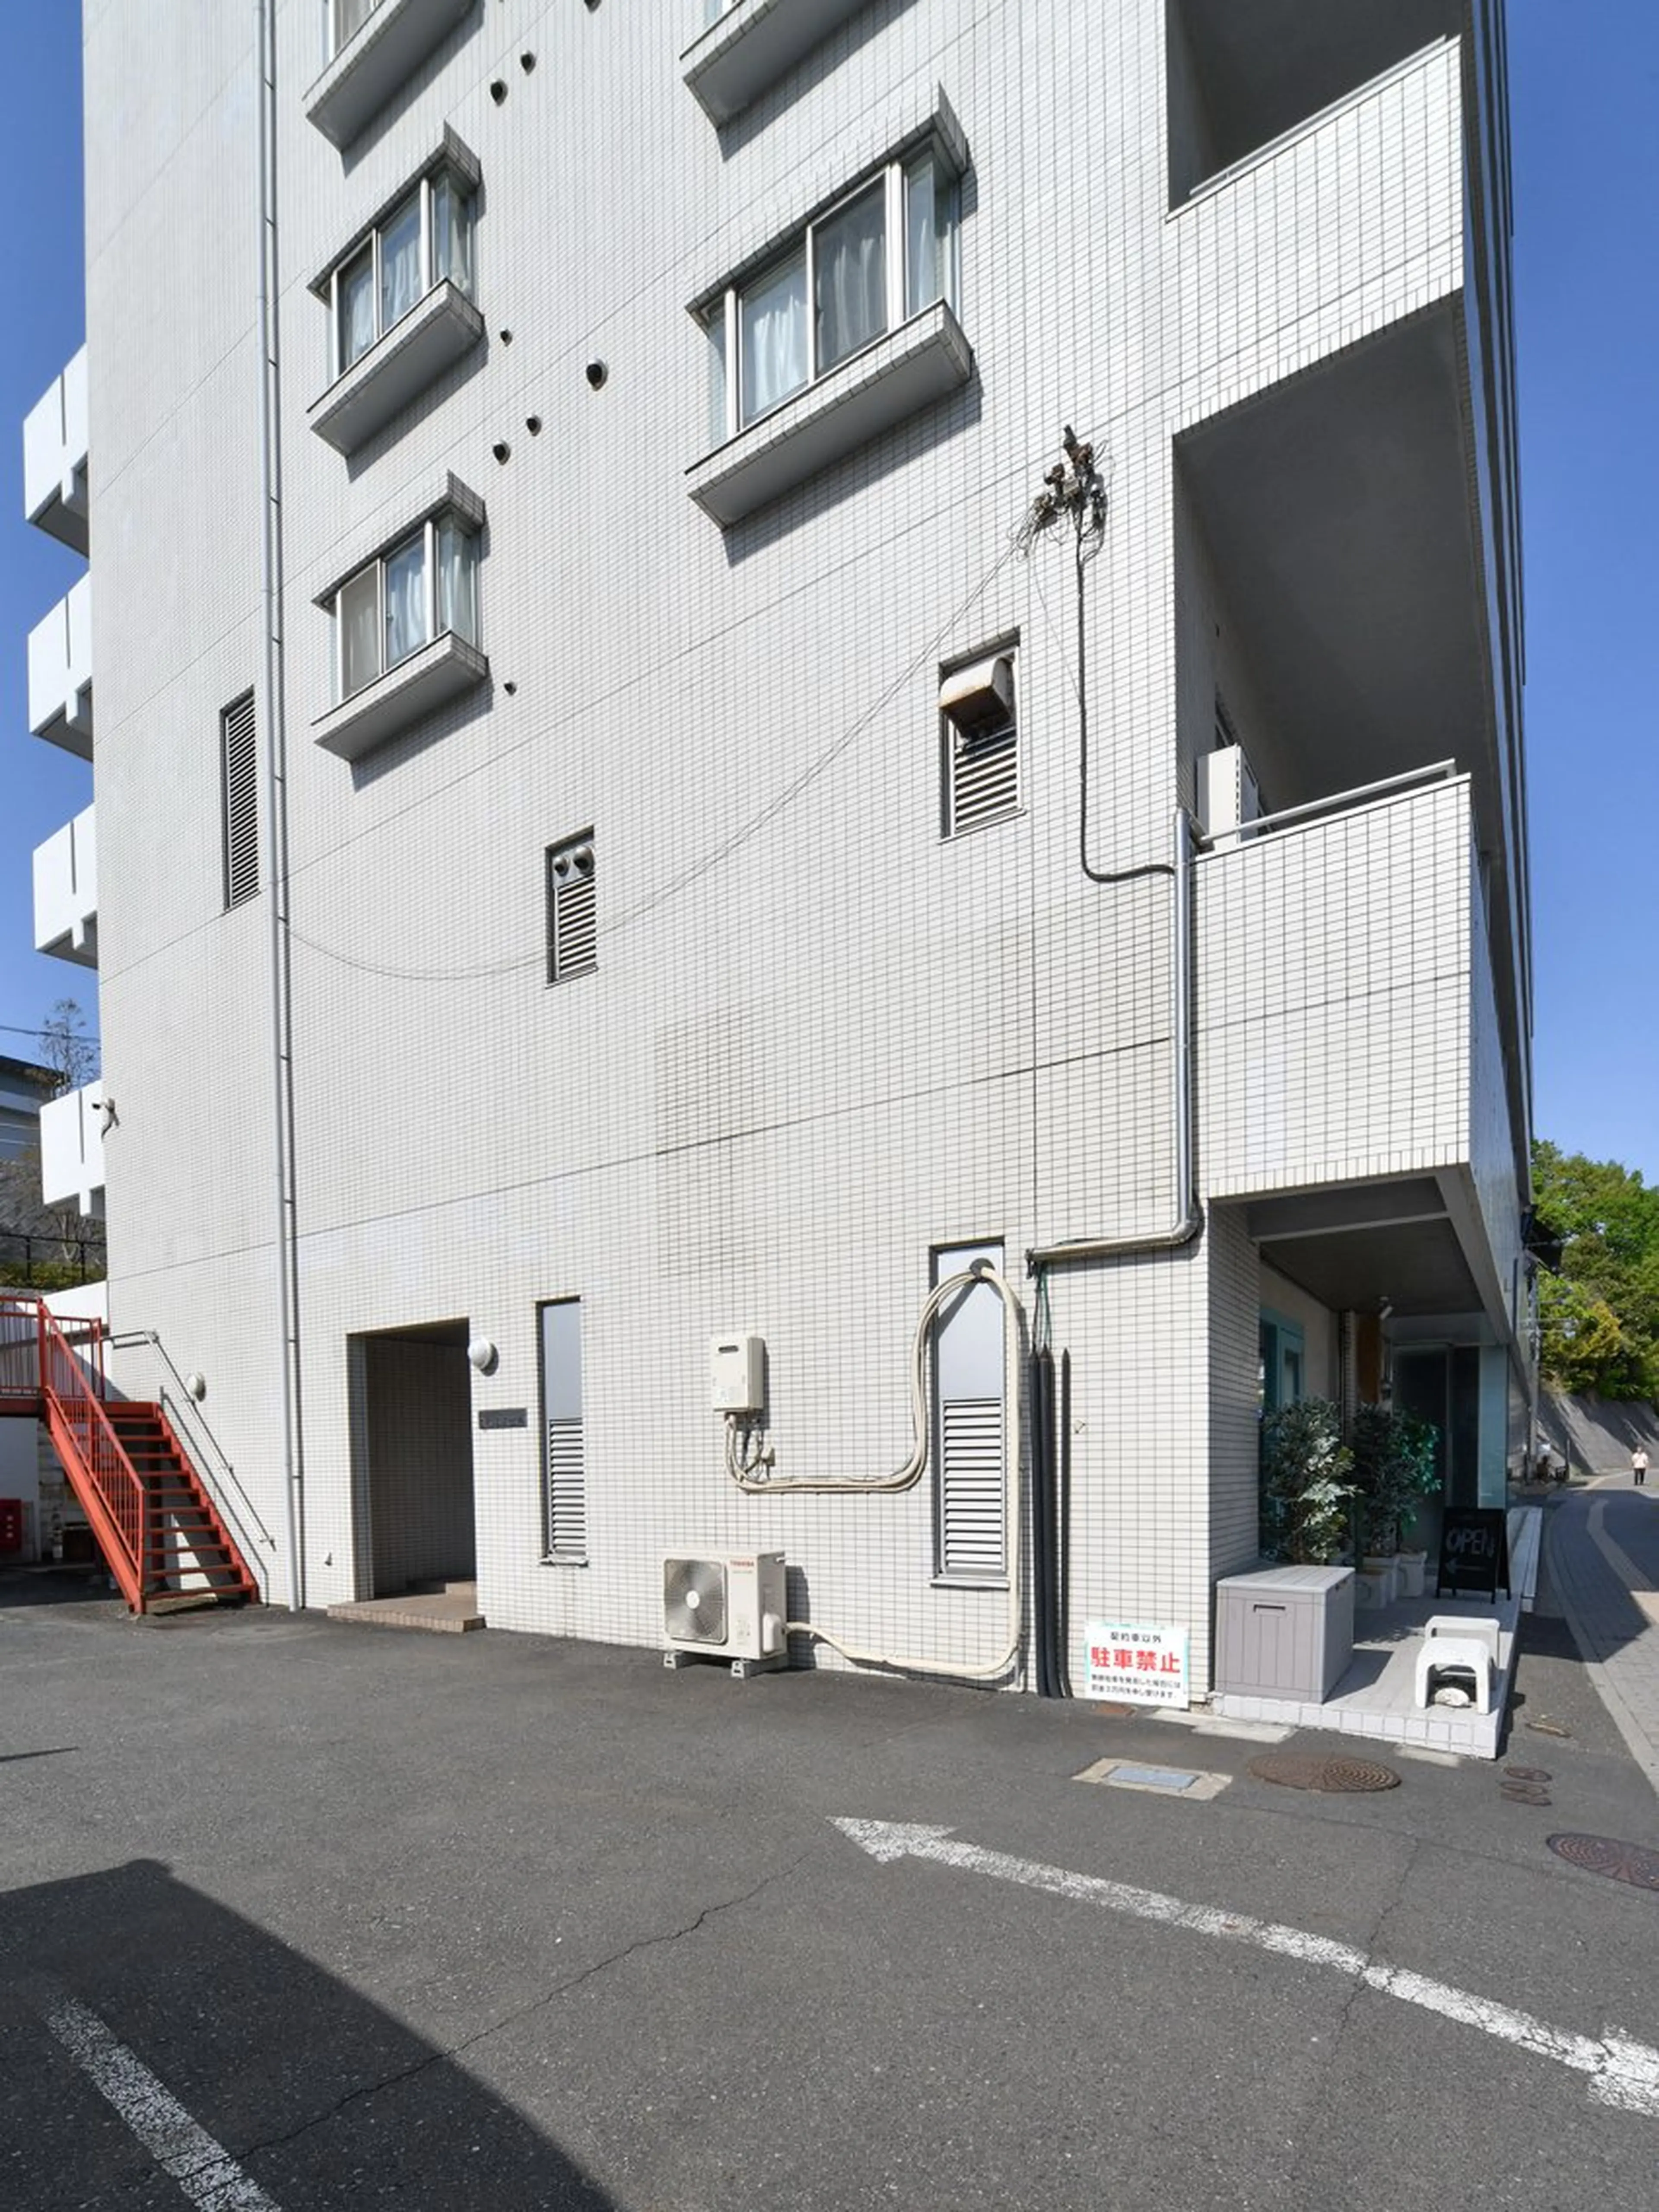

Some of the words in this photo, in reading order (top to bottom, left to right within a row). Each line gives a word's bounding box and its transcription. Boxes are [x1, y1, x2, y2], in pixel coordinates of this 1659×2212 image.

[1446, 1527, 1495, 1558] OPEN
[1091, 1646, 1180, 1673] 駐車禁止
